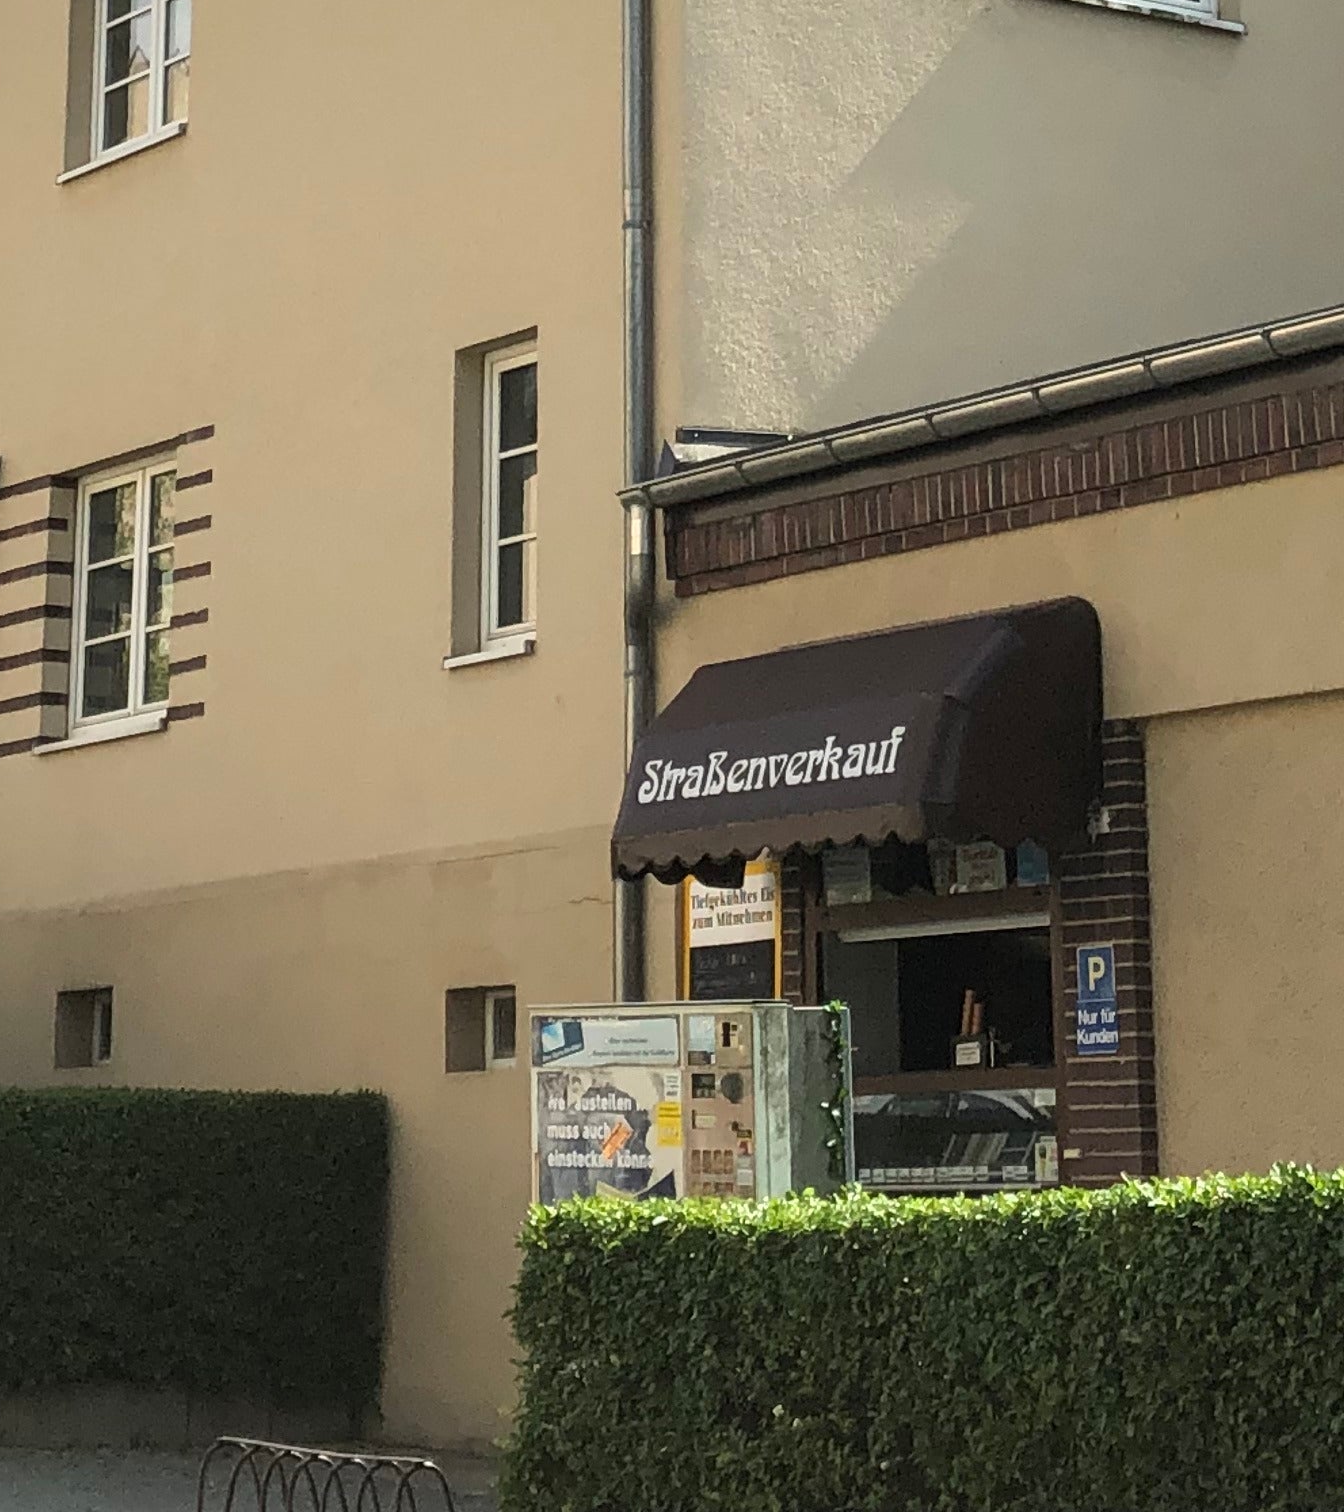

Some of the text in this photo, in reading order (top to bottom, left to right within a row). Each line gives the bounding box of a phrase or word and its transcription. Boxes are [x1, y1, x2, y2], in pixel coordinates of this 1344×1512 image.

[637, 726, 906, 804] Straßenverkauf
[1087, 956, 1106, 991] P
[1077, 1007, 1116, 1025] Nur für
[1076, 1028, 1119, 1045] Kunden
[546, 1123, 580, 1140] muss
